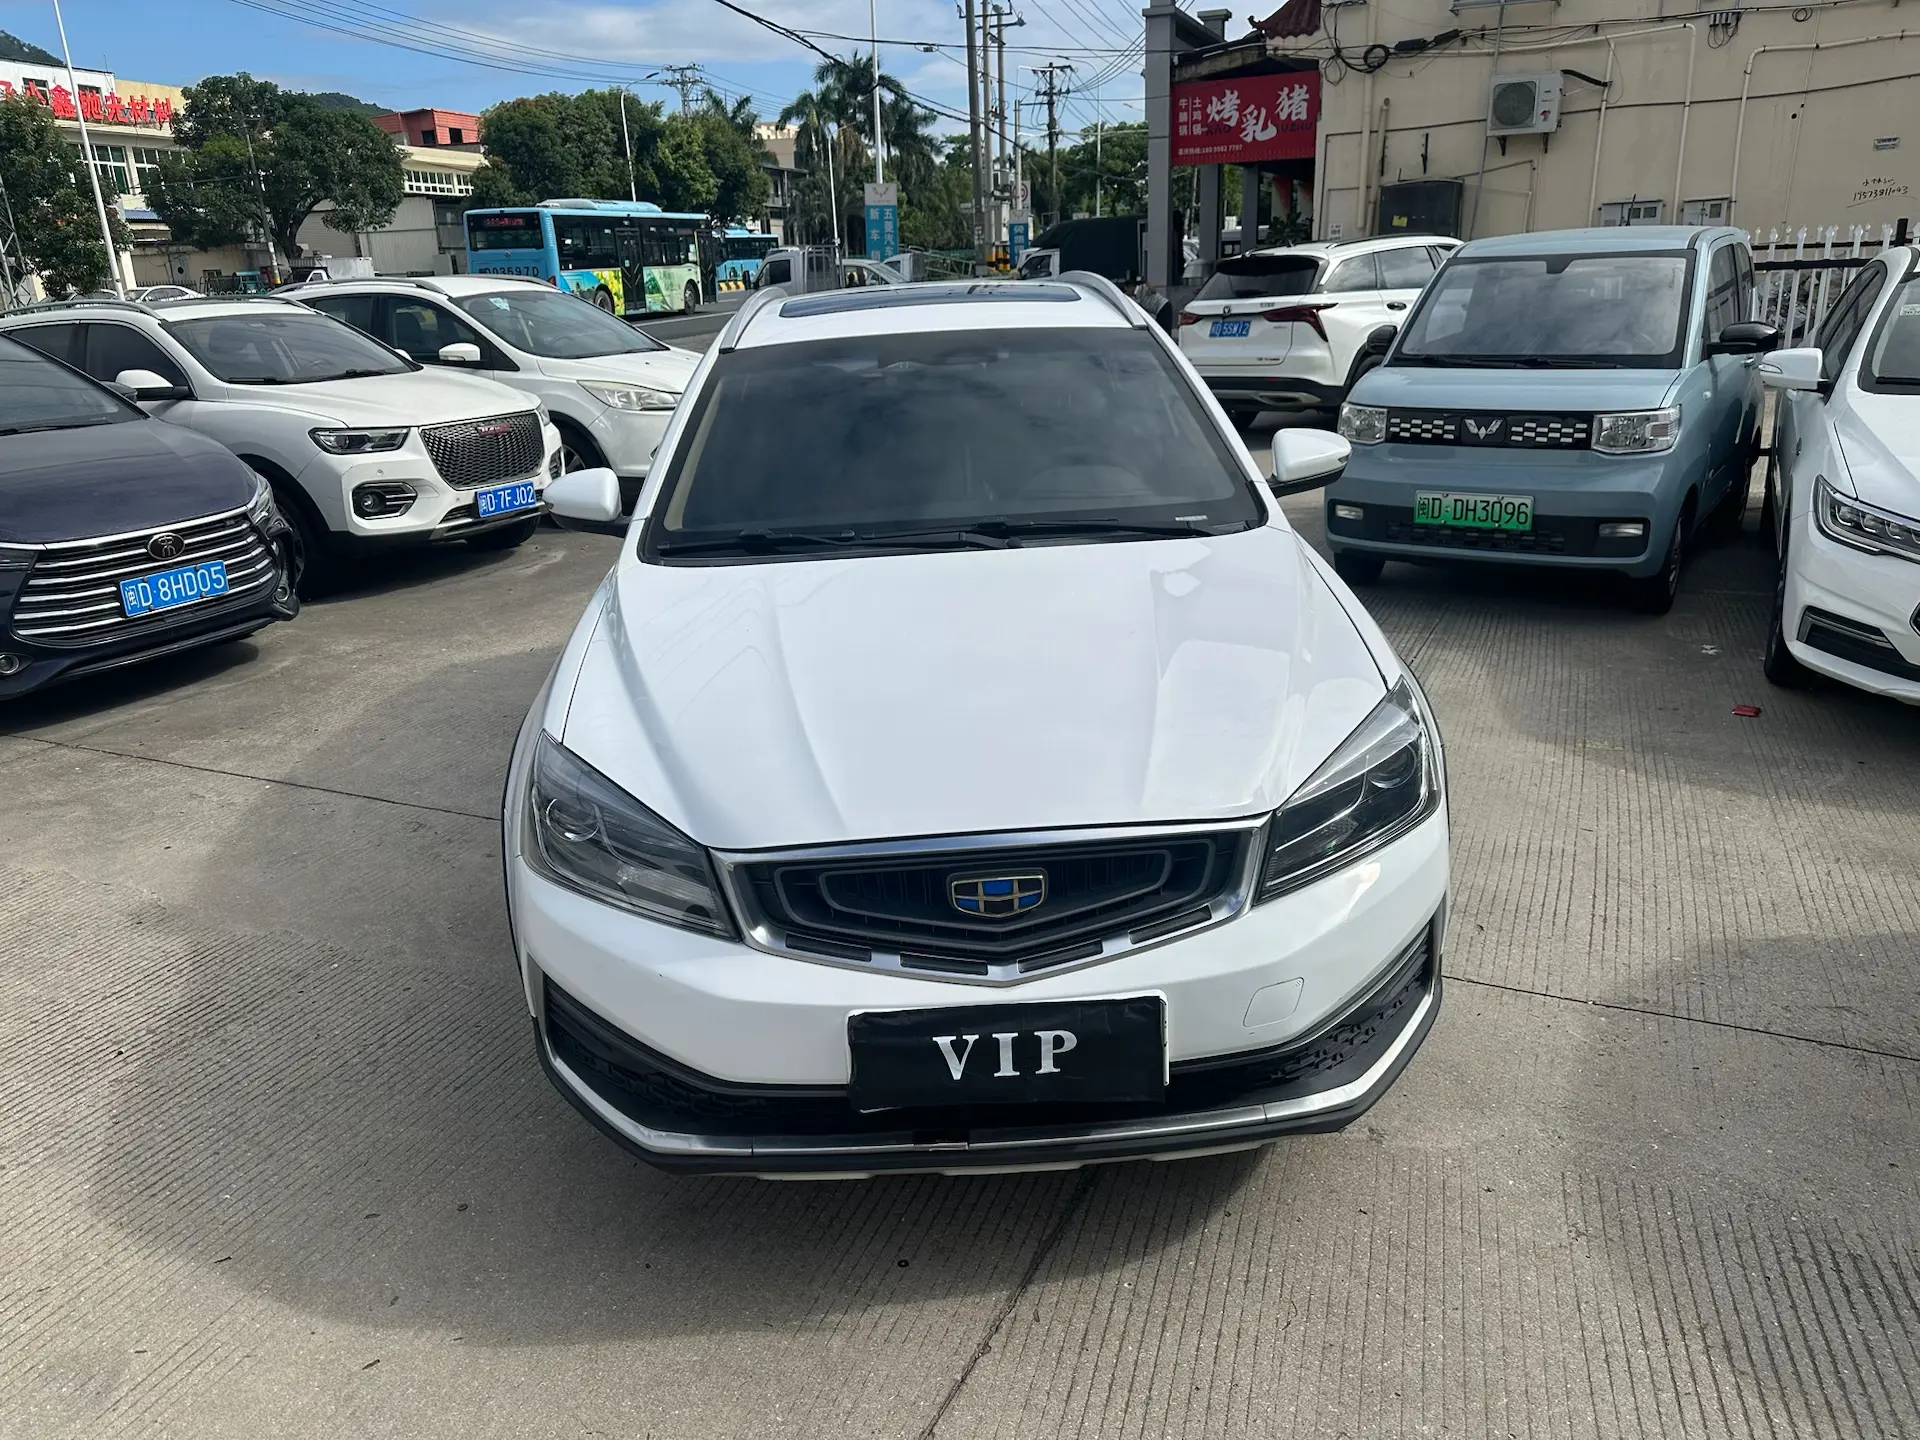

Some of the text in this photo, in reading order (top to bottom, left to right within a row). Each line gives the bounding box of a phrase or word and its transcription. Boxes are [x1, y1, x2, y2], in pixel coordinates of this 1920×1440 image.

[1206, 84, 1310, 143] 烤乳猪
[932, 1030, 1078, 1081] VIP
